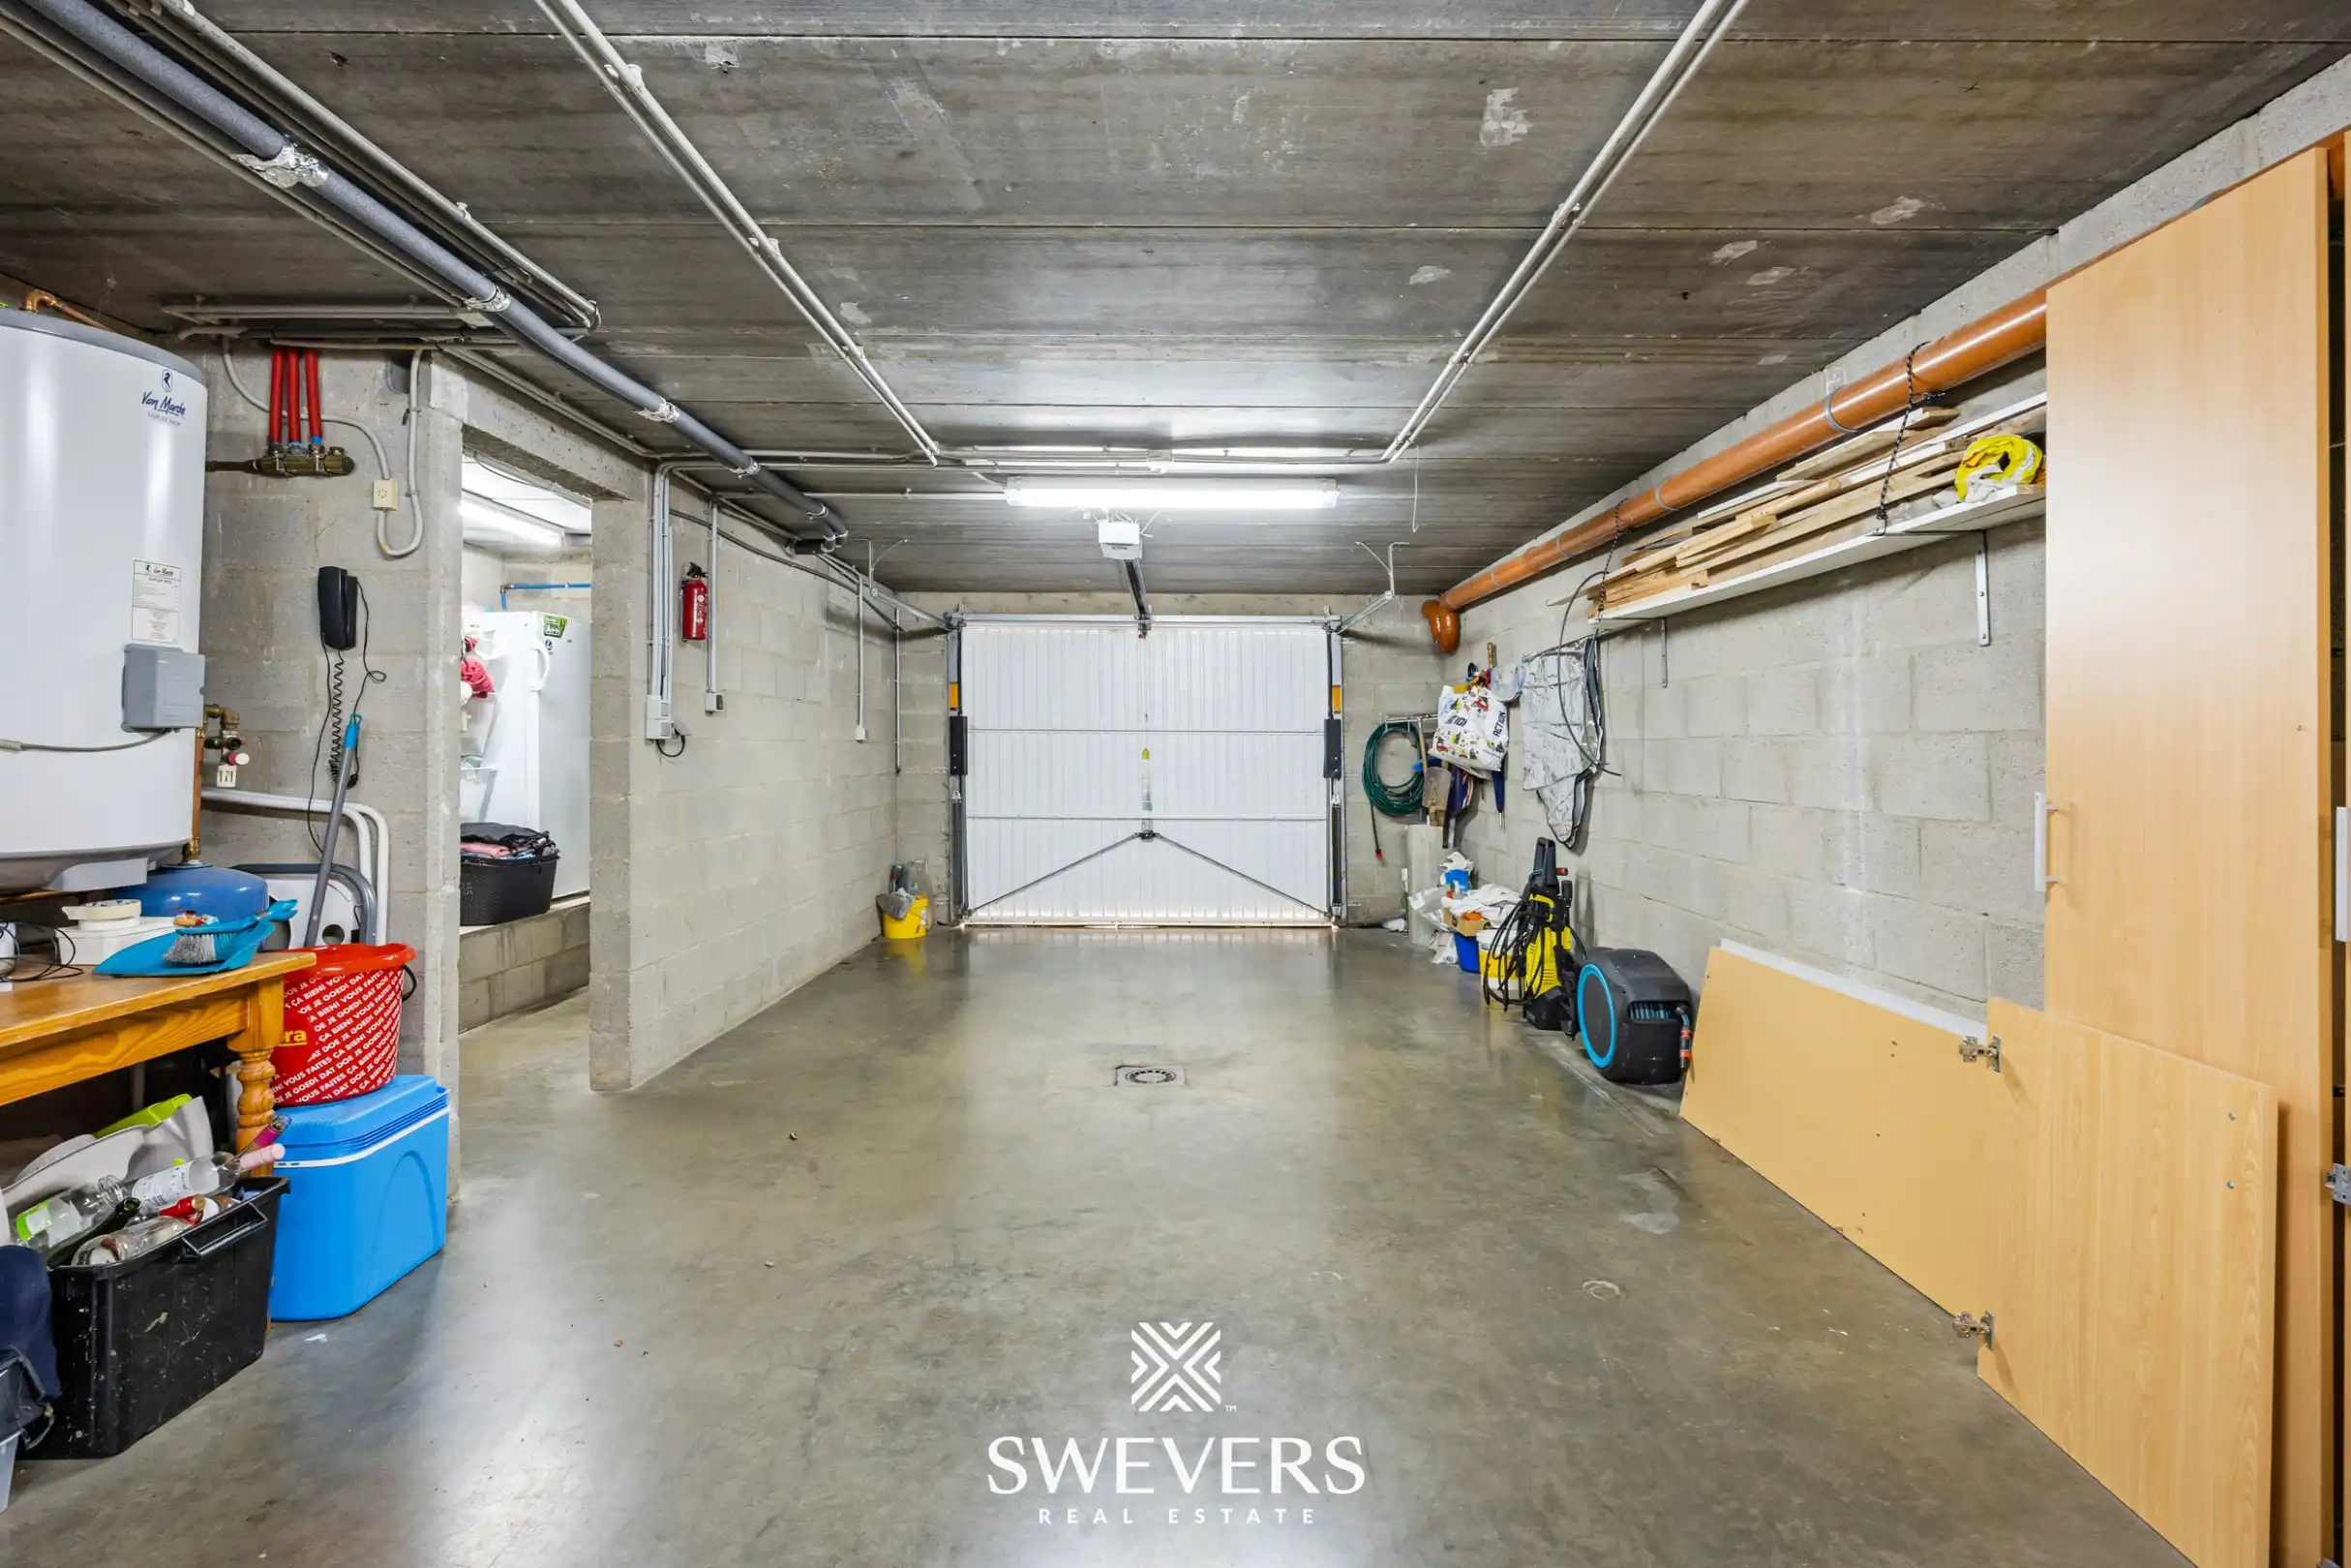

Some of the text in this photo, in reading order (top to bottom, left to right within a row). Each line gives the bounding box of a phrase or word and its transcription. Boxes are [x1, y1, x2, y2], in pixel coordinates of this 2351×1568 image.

[340, 985, 364, 1003] VOUS
[353, 1001, 376, 1019] VOUS
[284, 1029, 307, 1044] ra
[321, 1039, 341, 1053] DOE
[306, 1055, 333, 1075] FAITES
[318, 1066, 336, 1080] DAT
[336, 1055, 354, 1070] DOE
